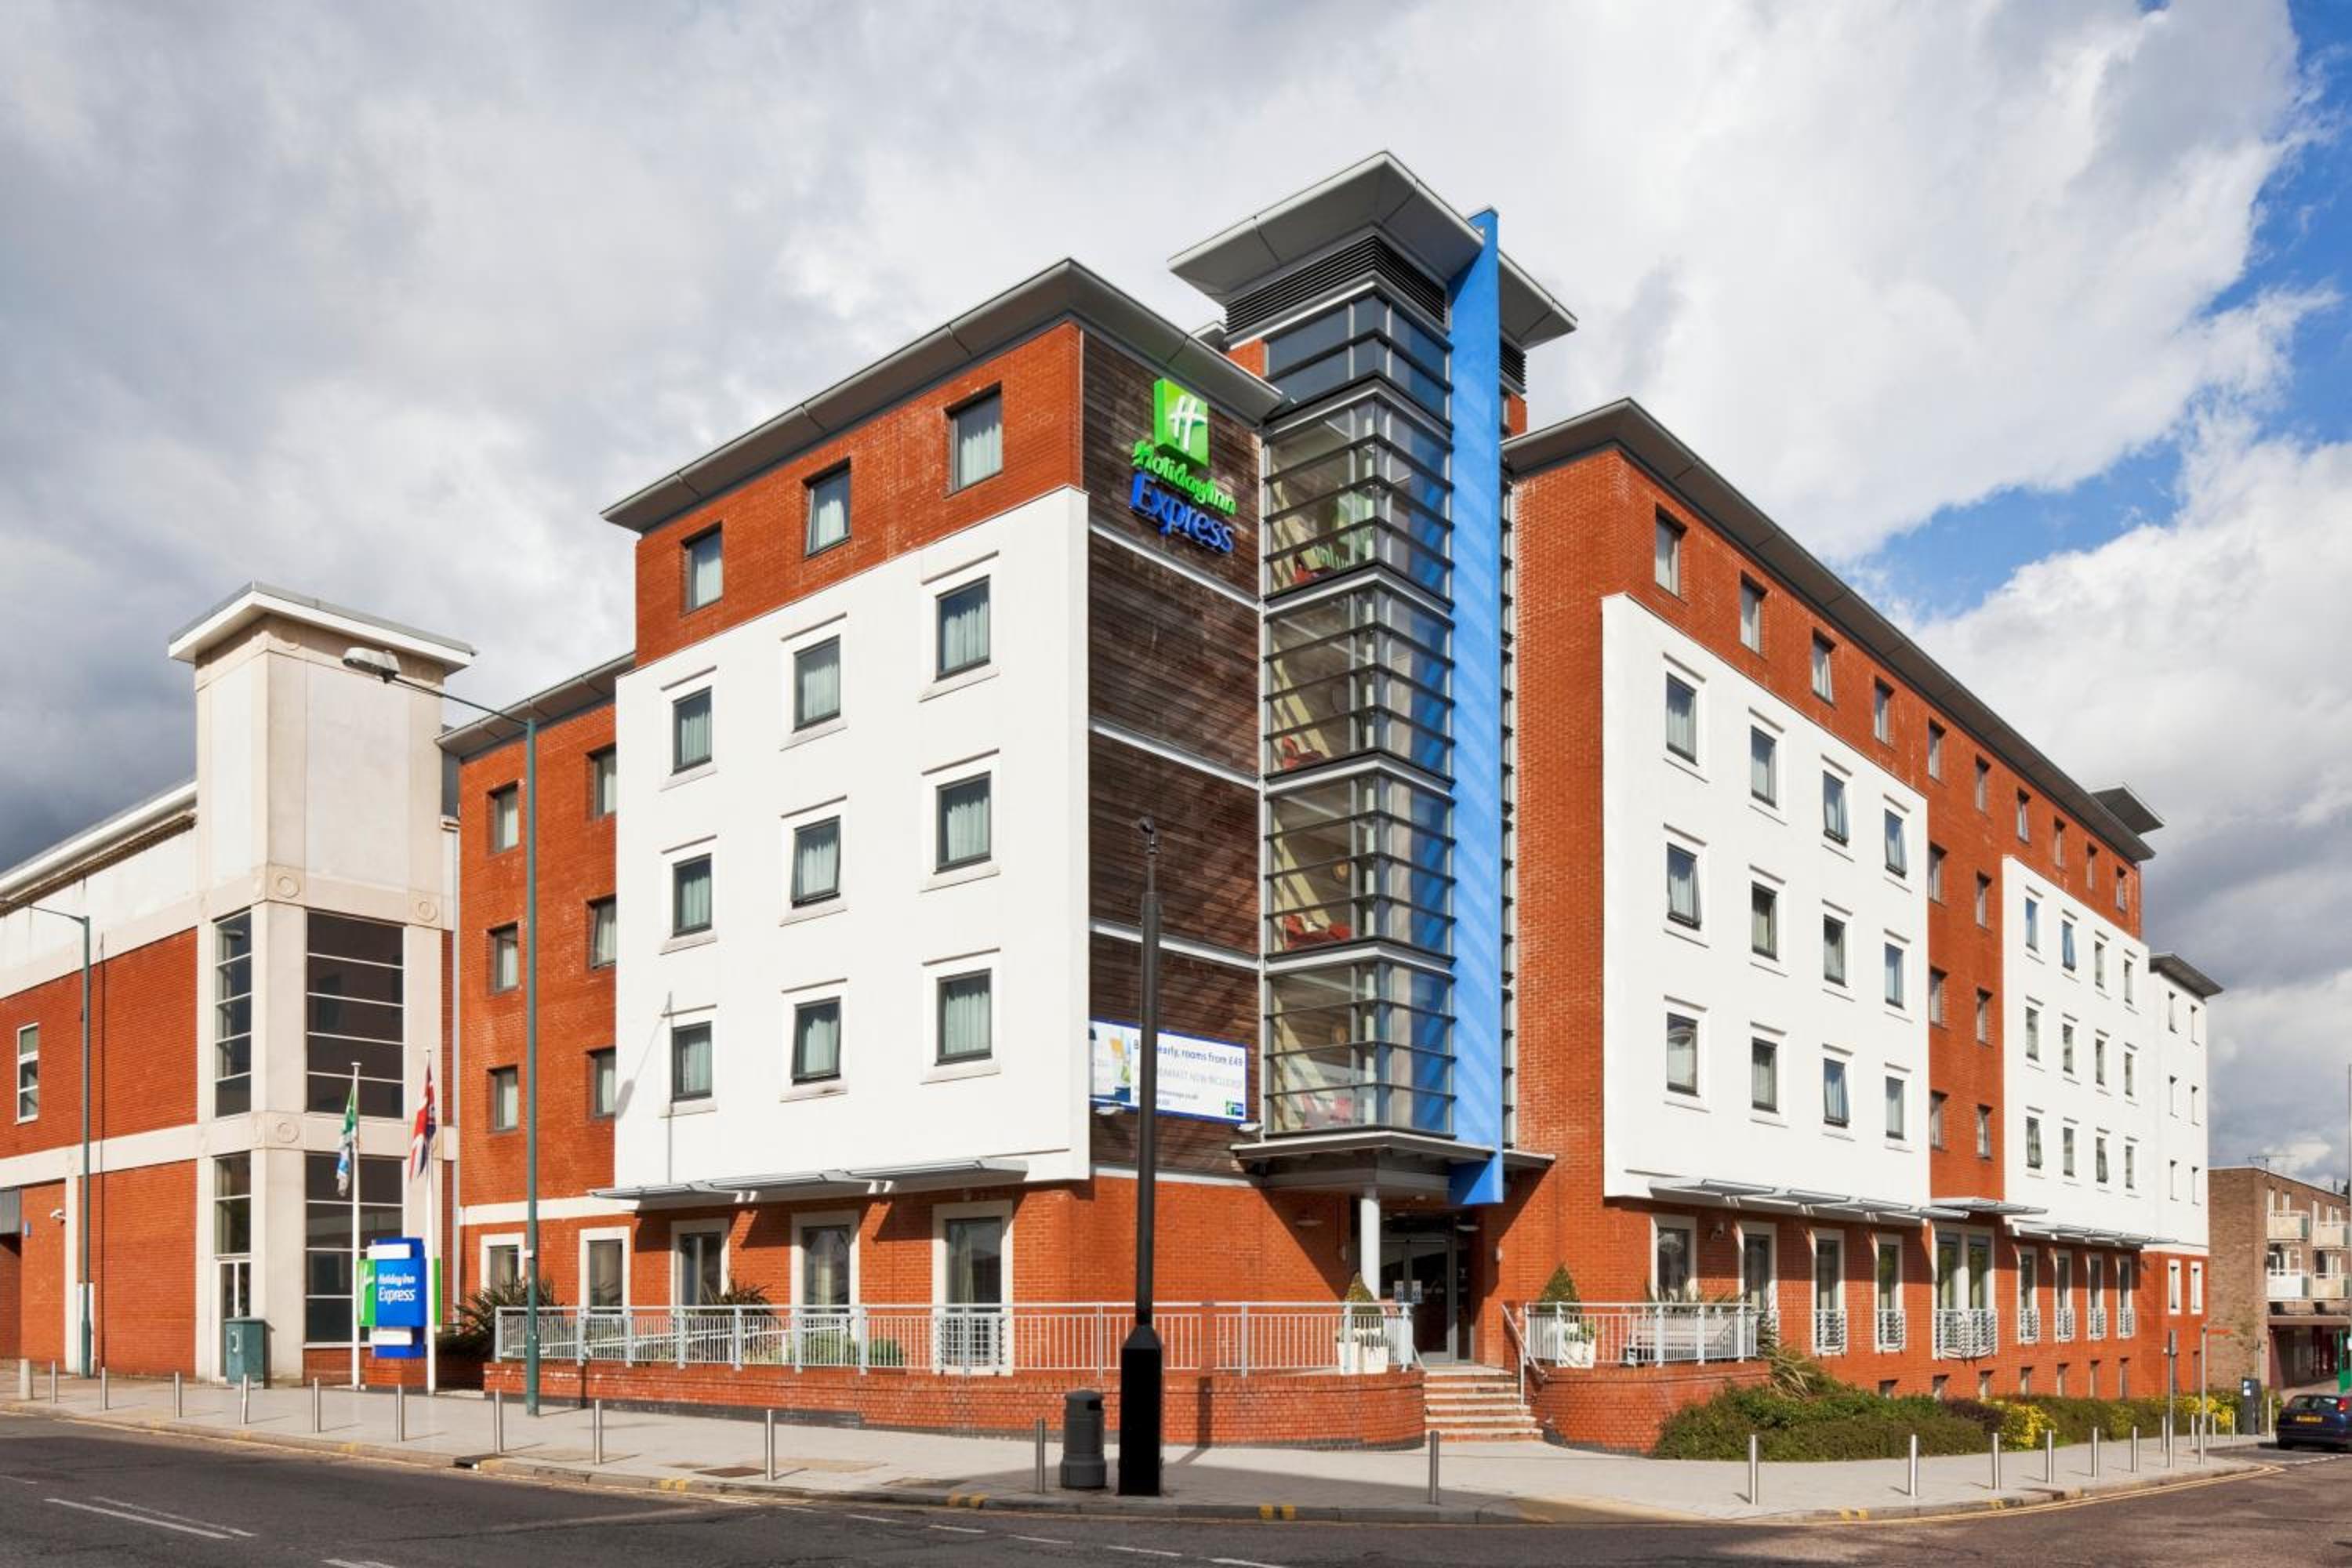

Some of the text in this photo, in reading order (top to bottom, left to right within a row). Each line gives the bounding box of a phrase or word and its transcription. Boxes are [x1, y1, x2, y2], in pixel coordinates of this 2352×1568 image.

[1132, 441, 1236, 516] Holiday Inn
[1130, 471, 1235, 553] Express
[1181, 1050, 1207, 1062] rooms
[1208, 1051, 1227, 1065] from
[378, 1287, 416, 1305] Express
